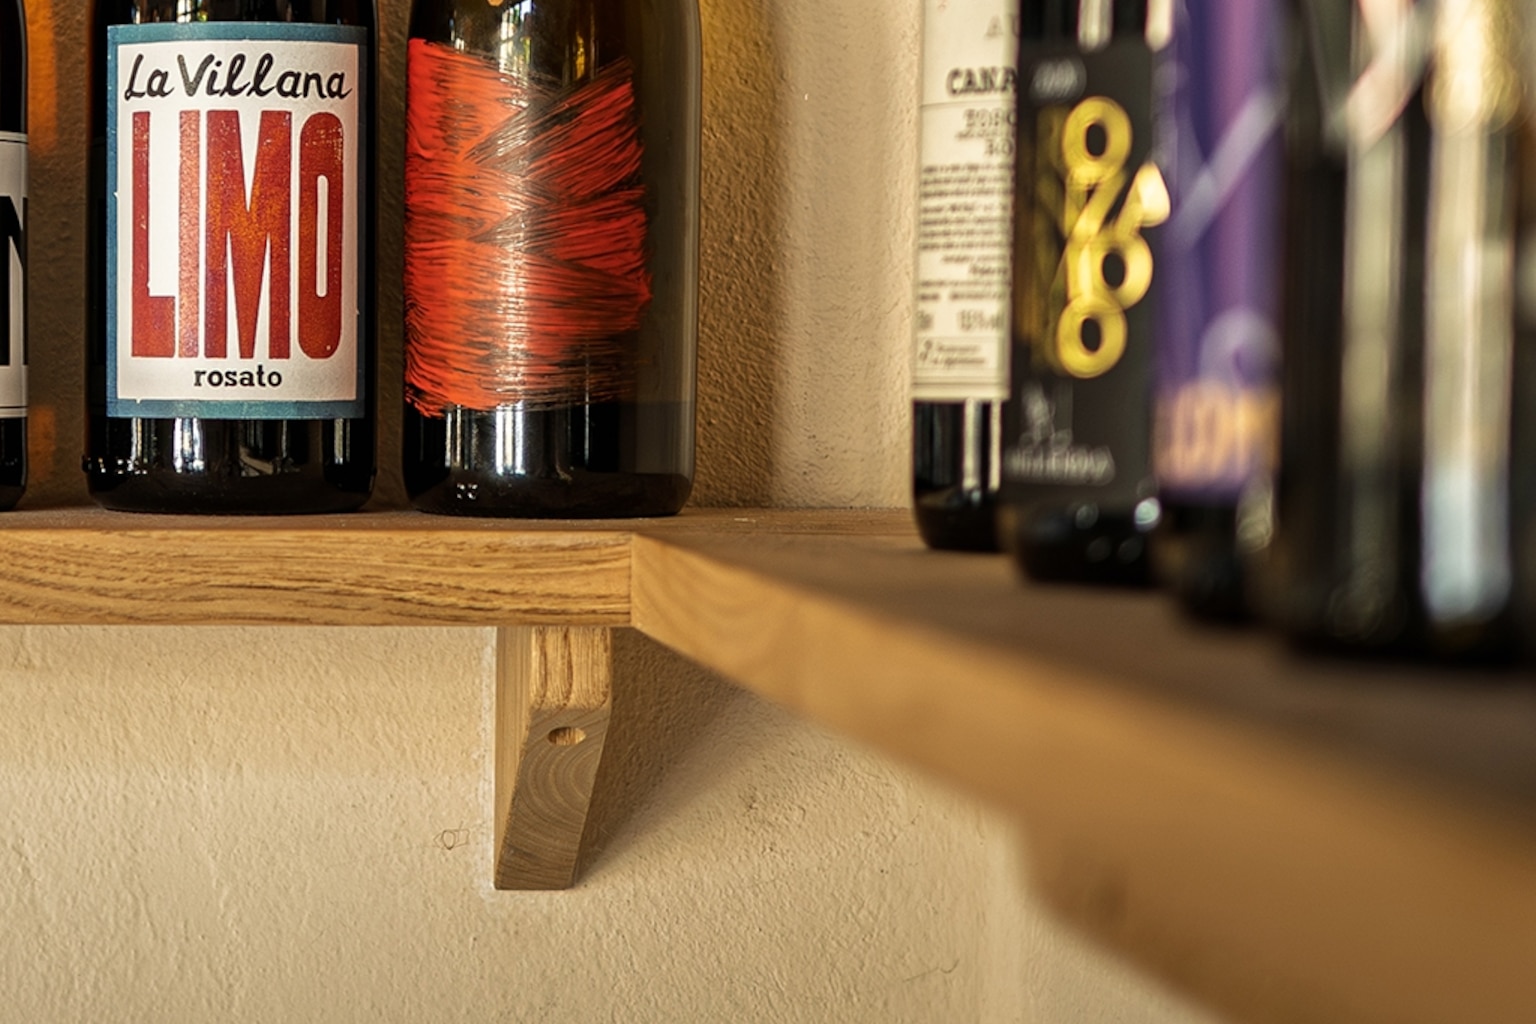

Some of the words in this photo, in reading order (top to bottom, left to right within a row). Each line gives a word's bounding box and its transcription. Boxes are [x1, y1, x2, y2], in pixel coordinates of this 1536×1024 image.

[124, 53, 175, 102] La
[177, 52, 353, 100] Villana
[131, 109, 344, 360] LIMO
[194, 366, 283, 388] rosato
